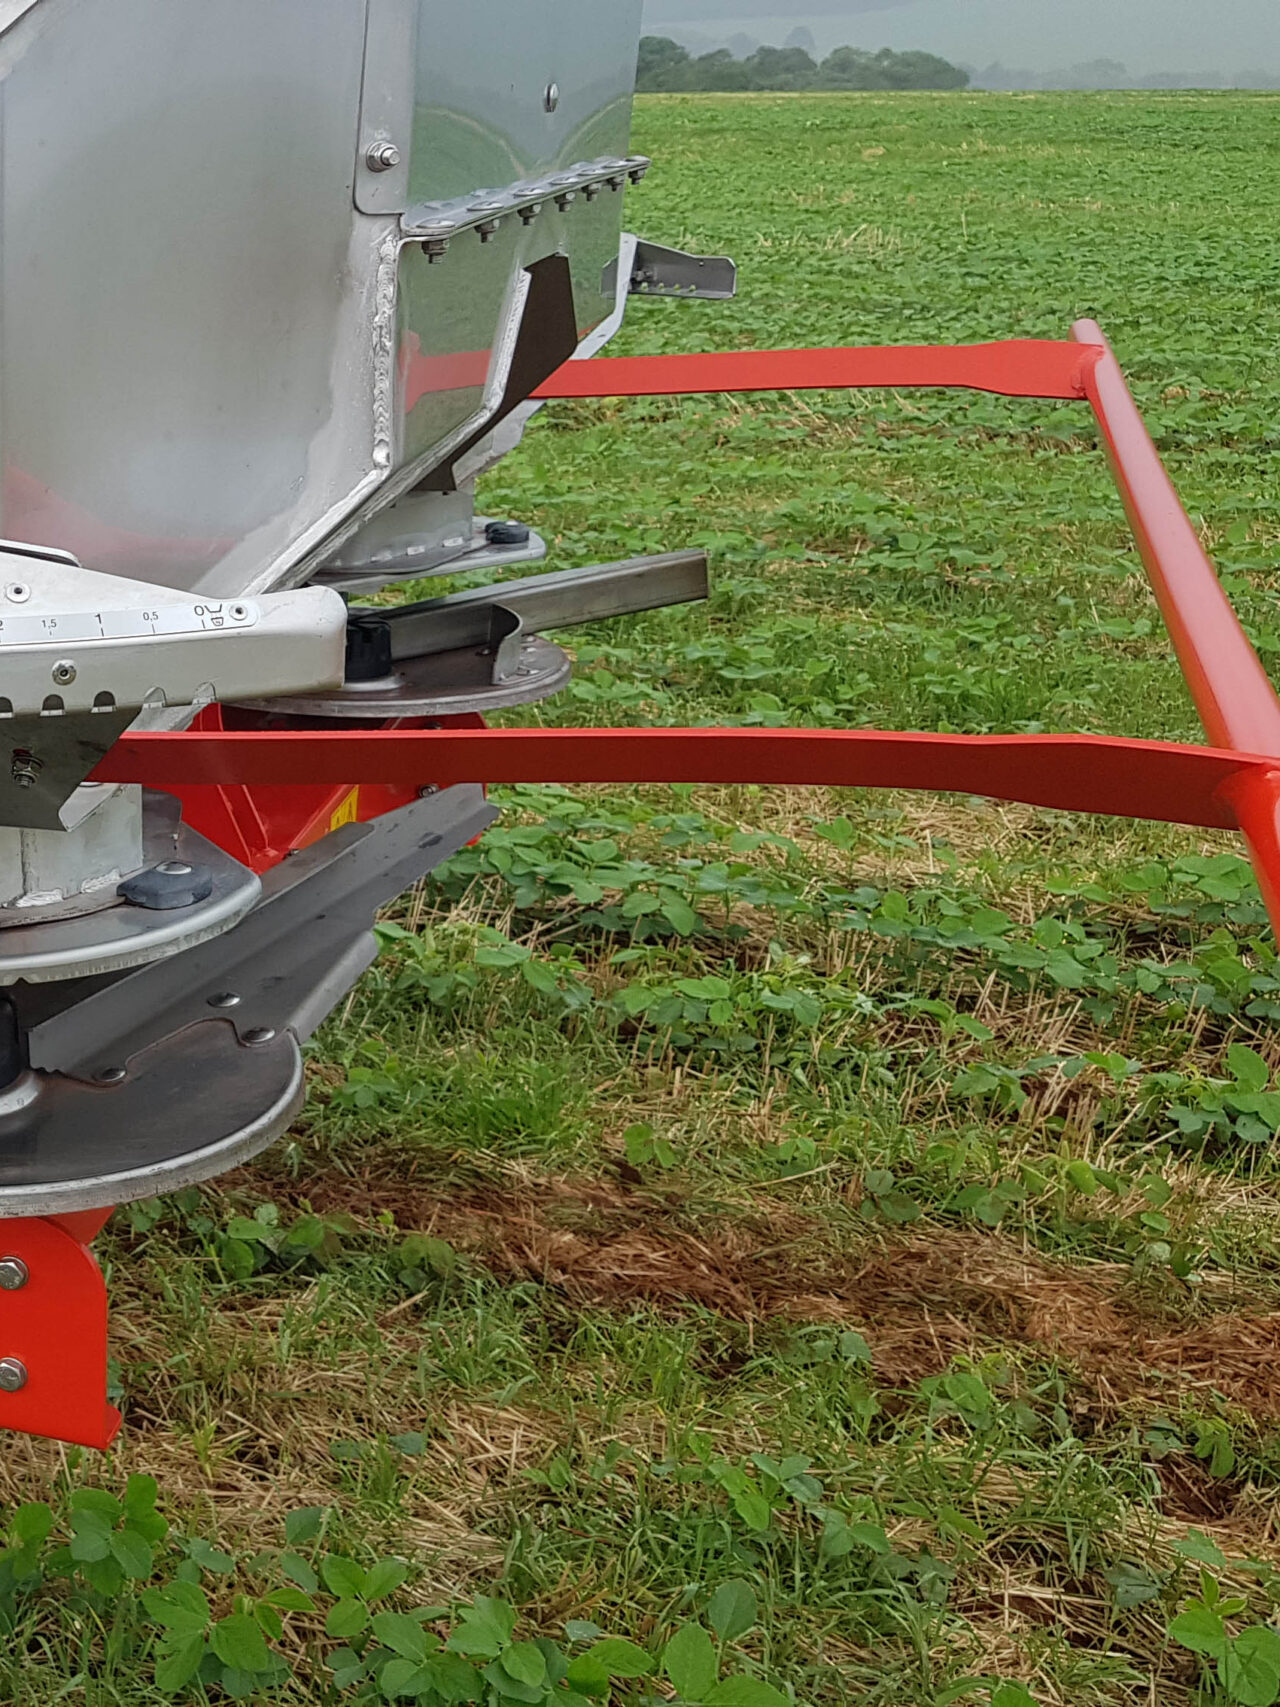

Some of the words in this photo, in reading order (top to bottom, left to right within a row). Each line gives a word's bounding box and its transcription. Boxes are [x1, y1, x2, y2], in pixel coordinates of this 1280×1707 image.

[42, 618, 57, 630] 1,5
[95, 614, 102, 624] 1
[143, 612, 159, 622] 0,5
[194, 605, 204, 616] 0
